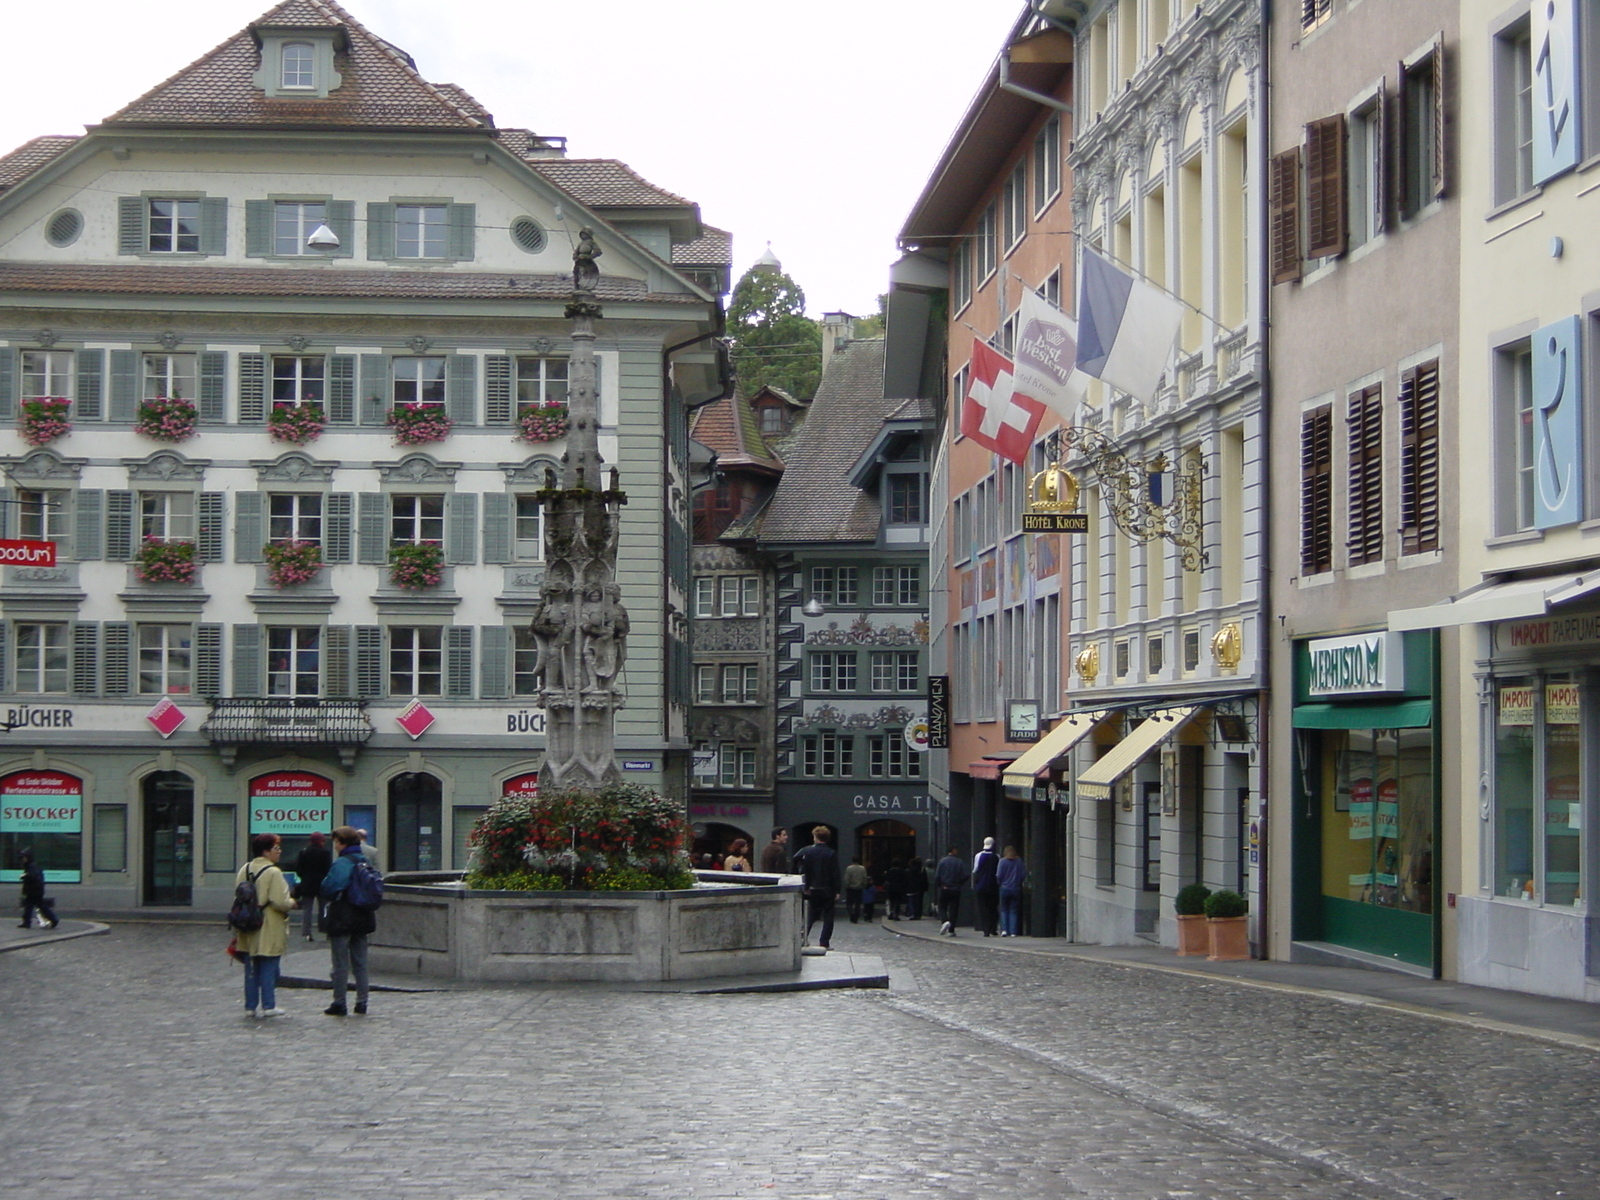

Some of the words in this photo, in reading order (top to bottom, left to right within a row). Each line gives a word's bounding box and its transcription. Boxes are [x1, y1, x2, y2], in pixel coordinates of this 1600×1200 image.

[1021, 338, 1068, 380] Western
[1032, 378, 1057, 397] Krone
[1056, 516, 1086, 529] KRONE
[1510, 622, 1551, 647] IMPORT
[1309, 643, 1363, 688] MEPHISTO
[1501, 690, 1534, 709] IMPORT
[8, 704, 74, 727] BÜCHER
[507, 709, 547, 732] BÜCH
[521, 781, 529, 789] ab
[853, 795, 901, 809] CASA
